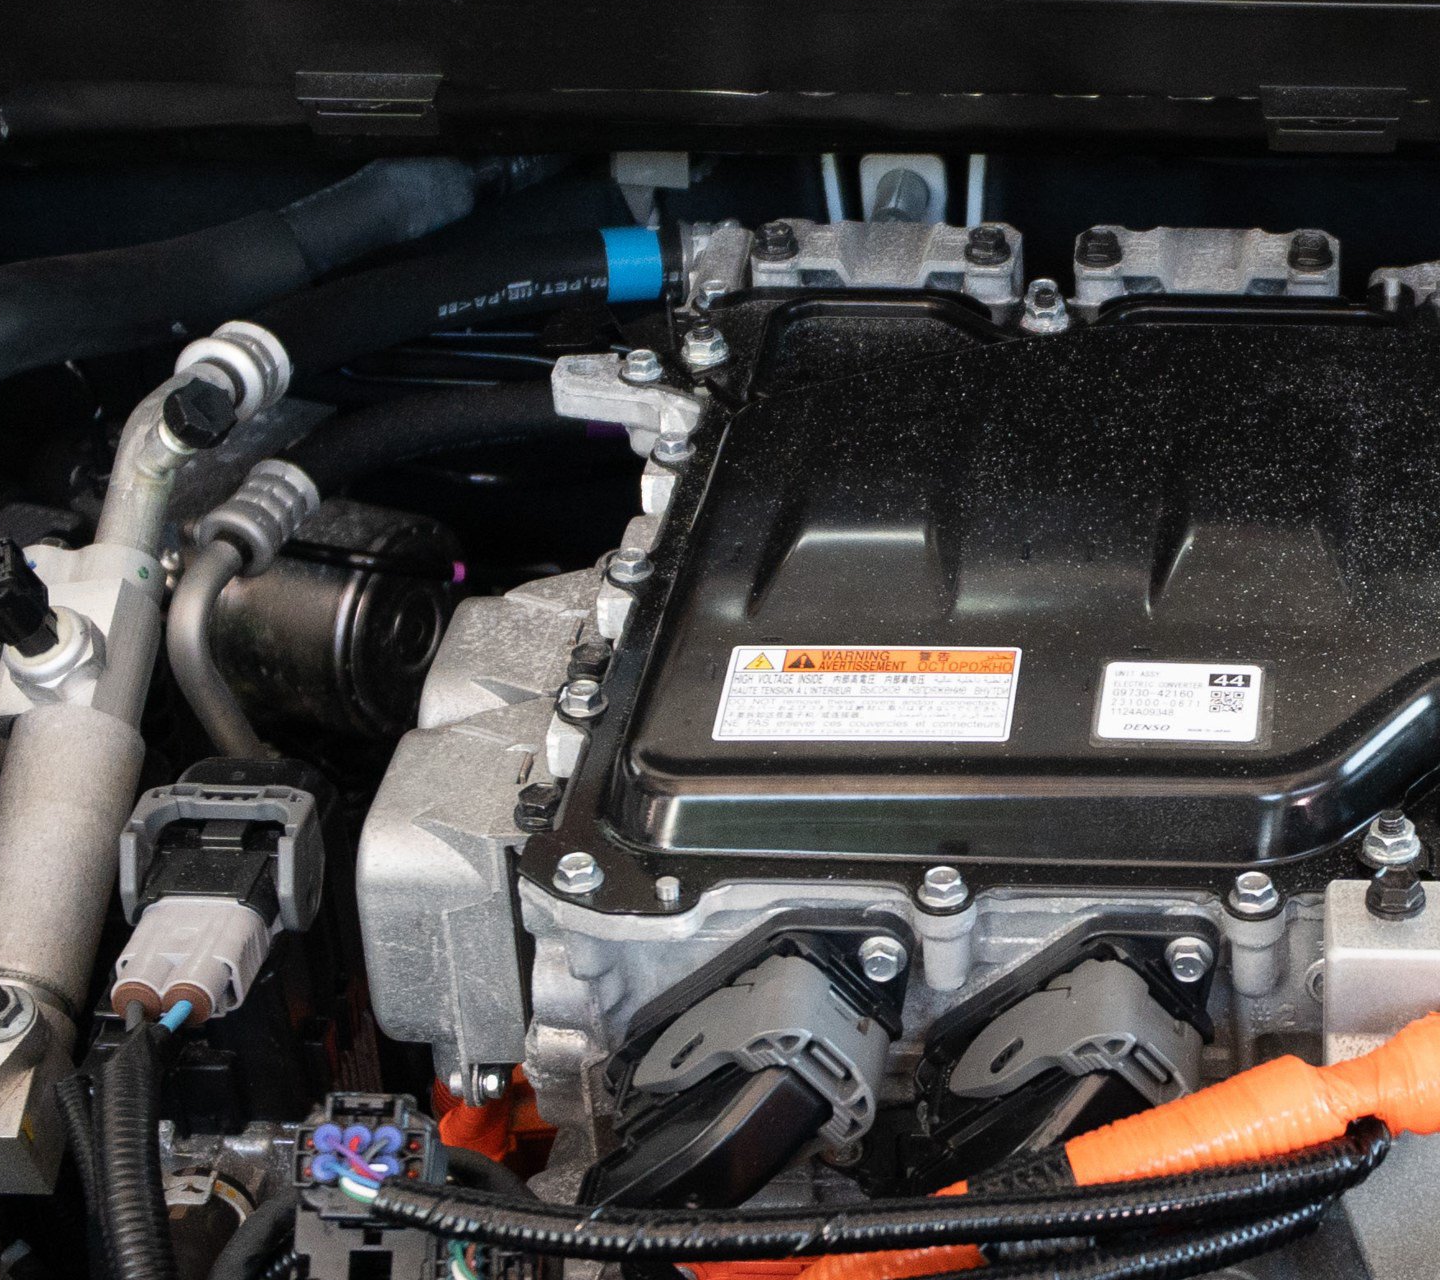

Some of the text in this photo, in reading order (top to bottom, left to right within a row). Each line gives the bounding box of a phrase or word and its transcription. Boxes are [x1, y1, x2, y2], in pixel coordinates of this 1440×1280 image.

[821, 650, 891, 661] WARNING
[919, 651, 951, 662] 警告
[817, 660, 907, 671] AVERTISSEMENT
[917, 661, 1013, 673] ОСТОРОЖНО
[734, 674, 824, 684] HIGH VOLTAGE INSIDE
[1213, 674, 1245, 687] 44
[1158, 681, 1204, 689] CONVERTER
[731, 686, 759, 695] HAUTE
[760, 686, 795, 695] TENSION
[747, 719, 769, 727] PAS
[1122, 723, 1171, 732] DENSO
